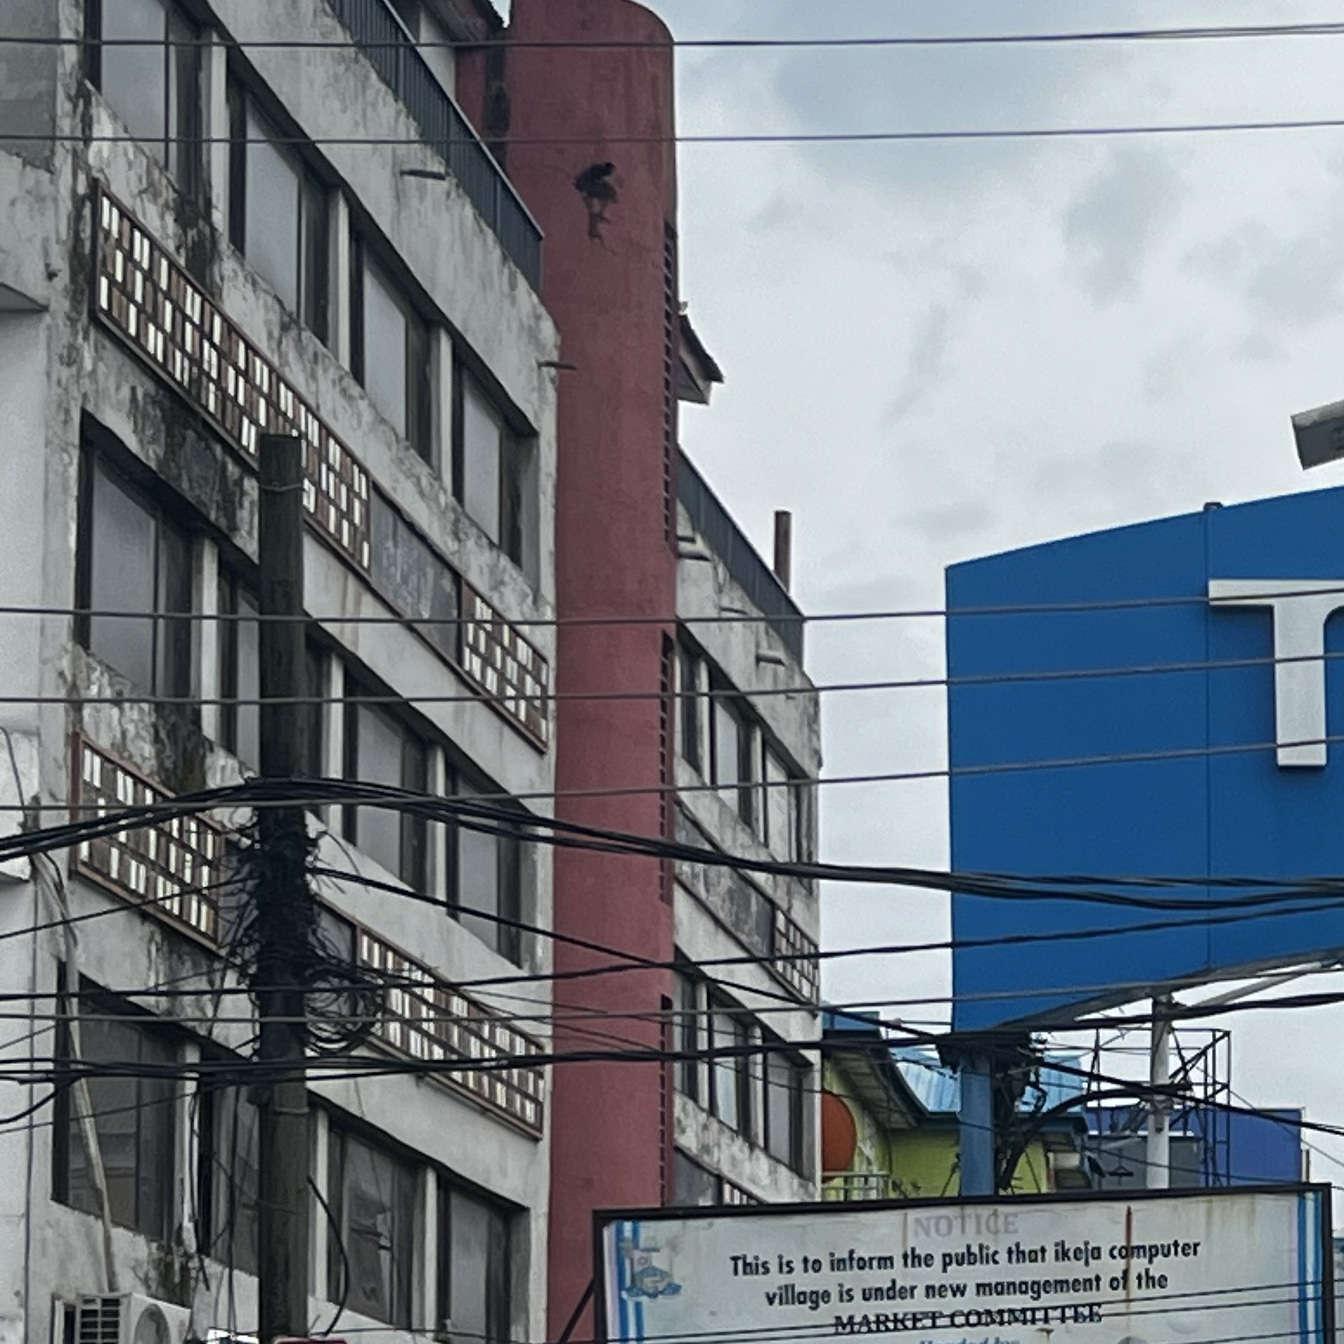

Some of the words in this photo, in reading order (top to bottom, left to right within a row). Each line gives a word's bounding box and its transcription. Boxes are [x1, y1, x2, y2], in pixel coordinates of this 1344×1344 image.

[913, 1210, 1019, 1239] NOTICE
[730, 1254, 770, 1277] This
[778, 1254, 794, 1274] is
[802, 1255, 822, 1274] to
[829, 1250, 895, 1272] inform
[902, 1247, 934, 1268] the
[942, 1243, 1000, 1273] public
[1007, 1242, 1048, 1264] that
[1054, 1240, 1101, 1267] ikeja
[1109, 1239, 1201, 1264] computer
[765, 1283, 831, 1311] village
[838, 1283, 854, 1303] is
[861, 1279, 918, 1301] under
[925, 1283, 967, 1299] new
[975, 1274, 1101, 1300] management
[1109, 1268, 1130, 1291] of
[1136, 1268, 1168, 1290] the
[834, 1310, 943, 1334] MARKET
